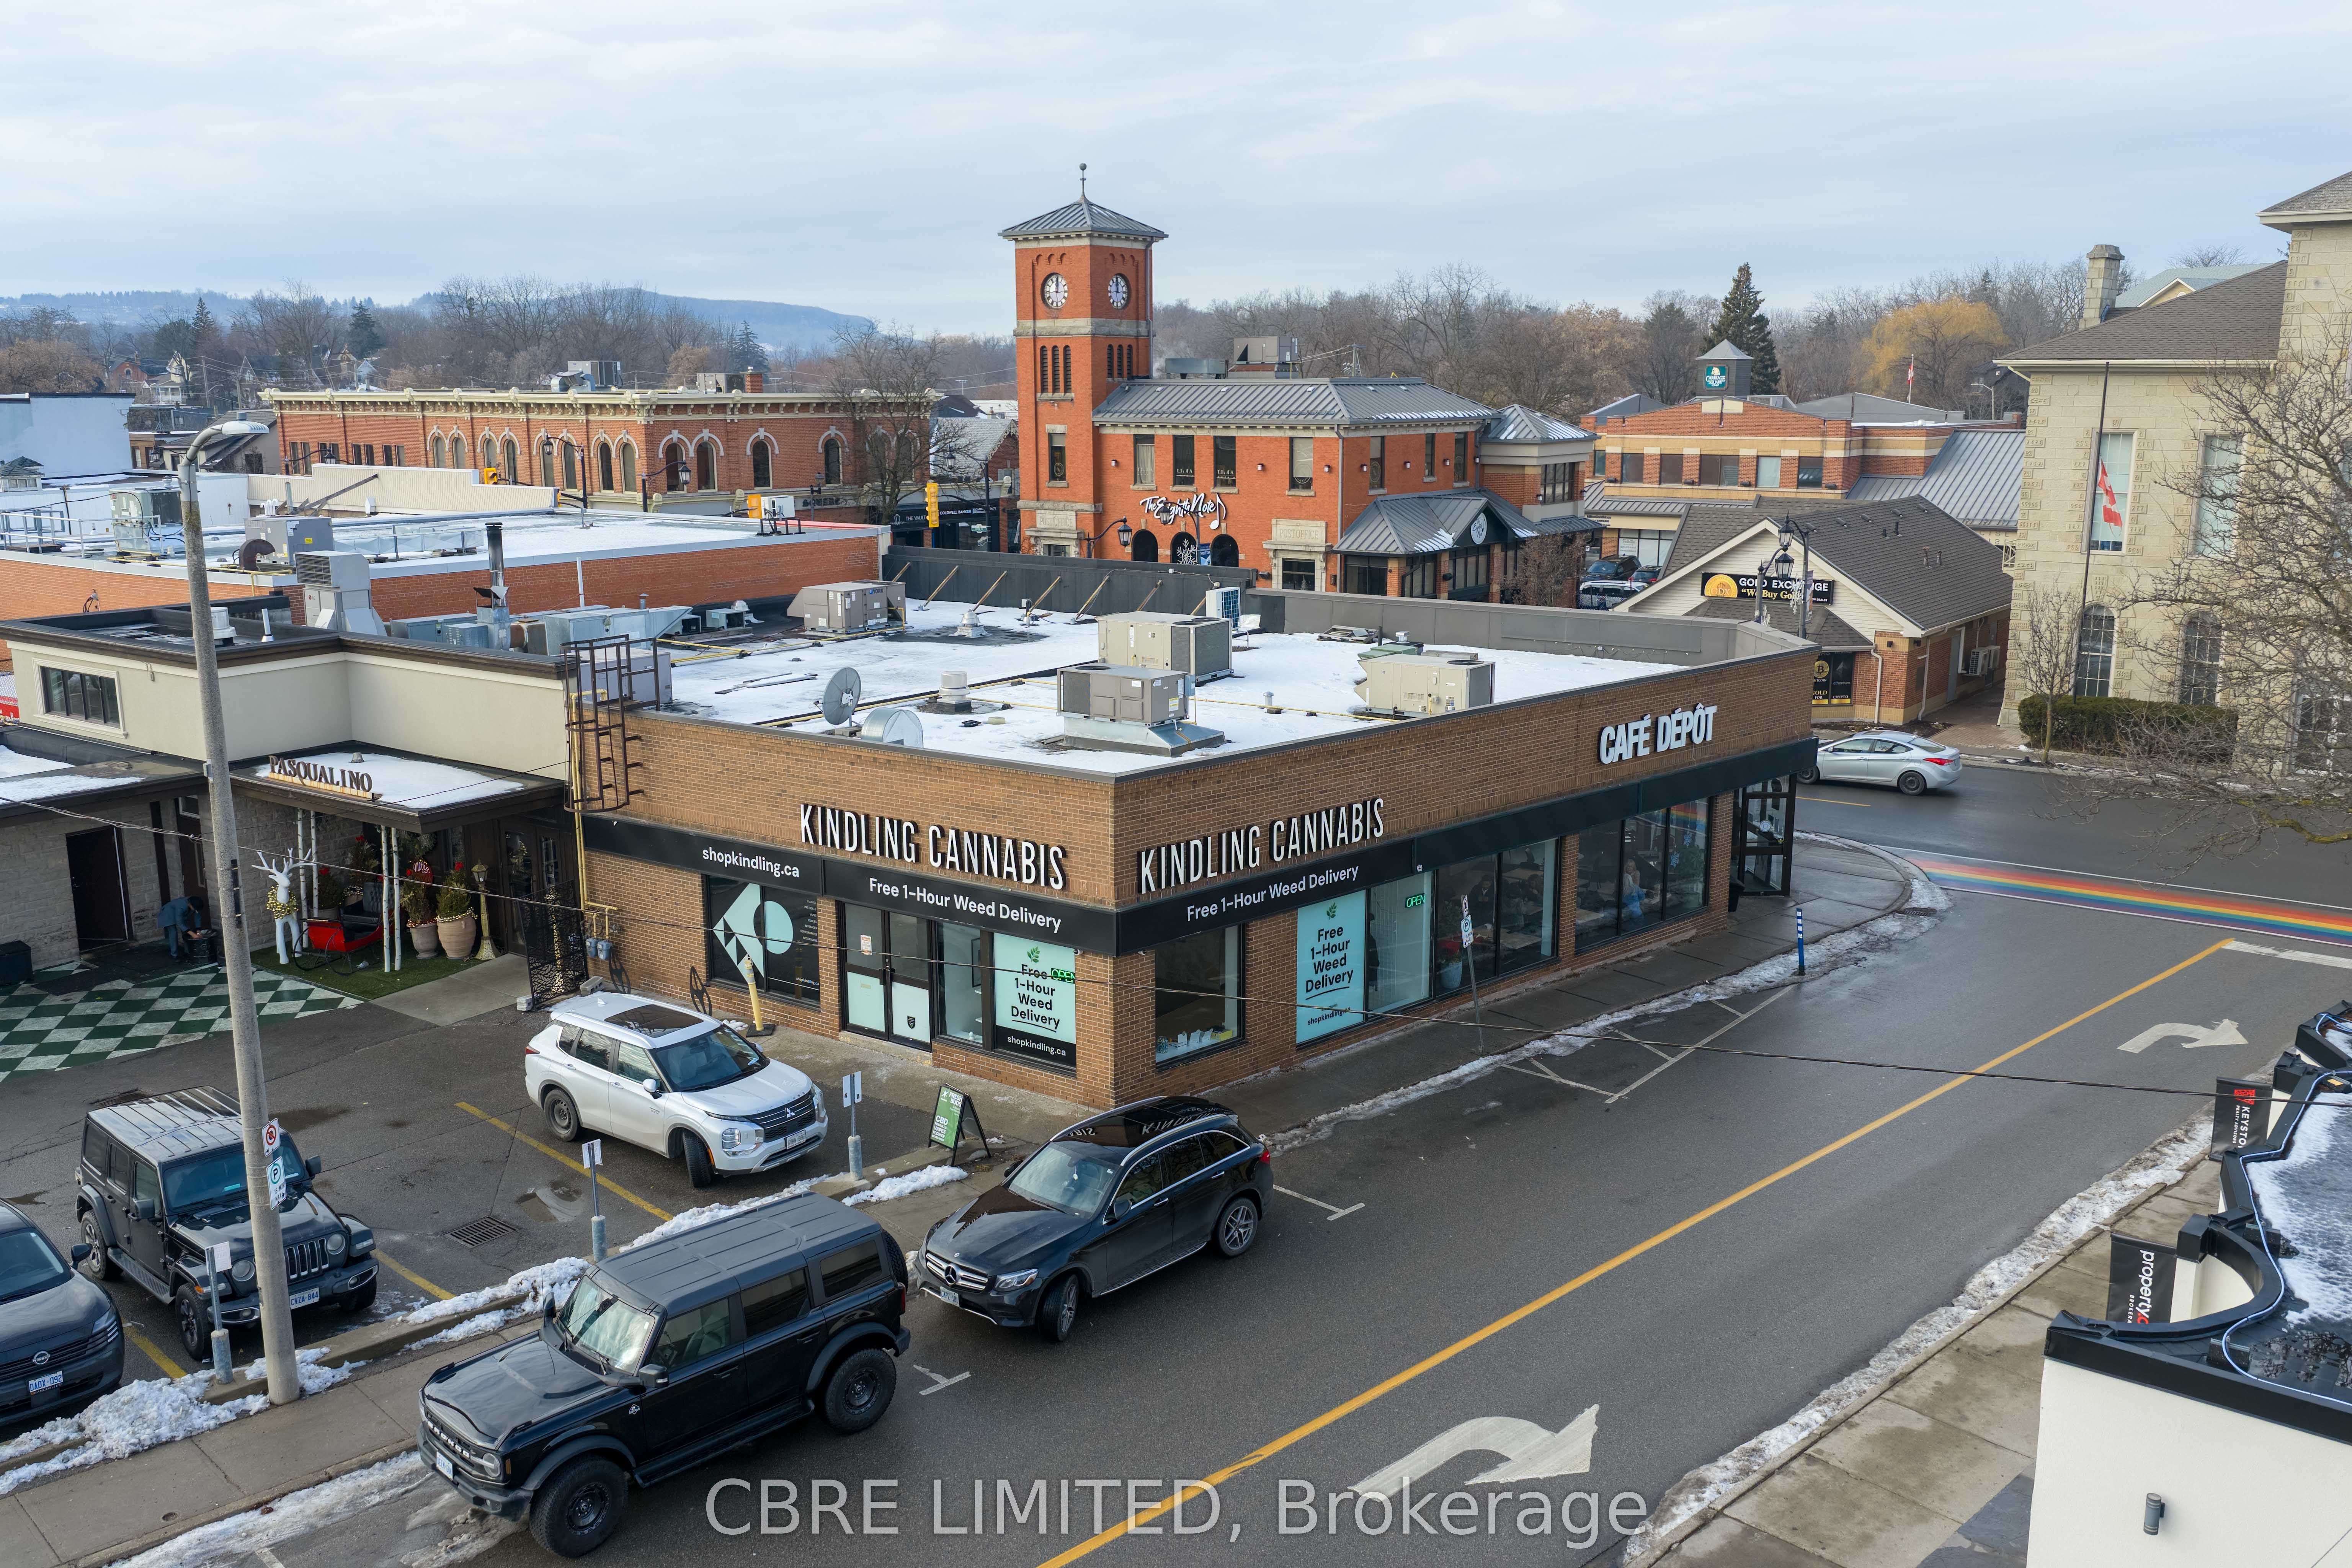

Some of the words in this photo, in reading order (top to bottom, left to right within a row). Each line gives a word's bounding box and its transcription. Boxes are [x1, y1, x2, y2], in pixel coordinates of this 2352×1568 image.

[1139, 496, 1156, 513] The
[1189, 493, 1216, 517] Note
[1040, 517, 1053, 526] POST
[1280, 529, 1295, 538] POST
[1296, 529, 1319, 539] OFFICE
[1762, 590, 1776, 600] Buy
[1600, 714, 1651, 764] CAFÉ
[1657, 702, 1717, 752] DÉPÔT
[268, 755, 372, 792] PASQUALINO
[800, 804, 917, 863] KINDLING
[928, 825, 1065, 890] CANNABIS
[1140, 825, 1260, 894] KINDLING
[1272, 798, 1384, 862] CANNABIS
[702, 846, 799, 877] shopkindling.ca
[1187, 903, 1218, 921] Free
[1221, 889, 1266, 912] 1-Hour
[1269, 876, 1306, 899] Weed
[1309, 866, 1359, 889] Delivery
[1406, 895, 1425, 908] OPEN
[870, 877, 899, 897] Free
[903, 884, 951, 908] 1-Hour
[954, 894, 995, 917] Weed
[1000, 903, 1062, 934] Delivery
[1318, 926, 1343, 942] Free
[1310, 939, 1350, 960] 1-Hour
[1021, 964, 1048, 980] Free
[1313, 953, 1347, 974] Weed
[1014, 977, 1055, 996] 1-Hour
[1306, 969, 1354, 993] Delivery
[1018, 992, 1052, 1010] Weed
[1011, 1005, 1060, 1030] Delivery
[1008, 1036, 1066, 1056] shopkindling.ca
[949, 1092, 963, 1102] FRESH
[950, 1099, 962, 1107] BUDS
[934, 1125, 946, 1134] VAPES
[936, 1116, 948, 1125] CBD
[273, 1168, 278, 1180] P
[30, 1379, 46, 1391] DADX
